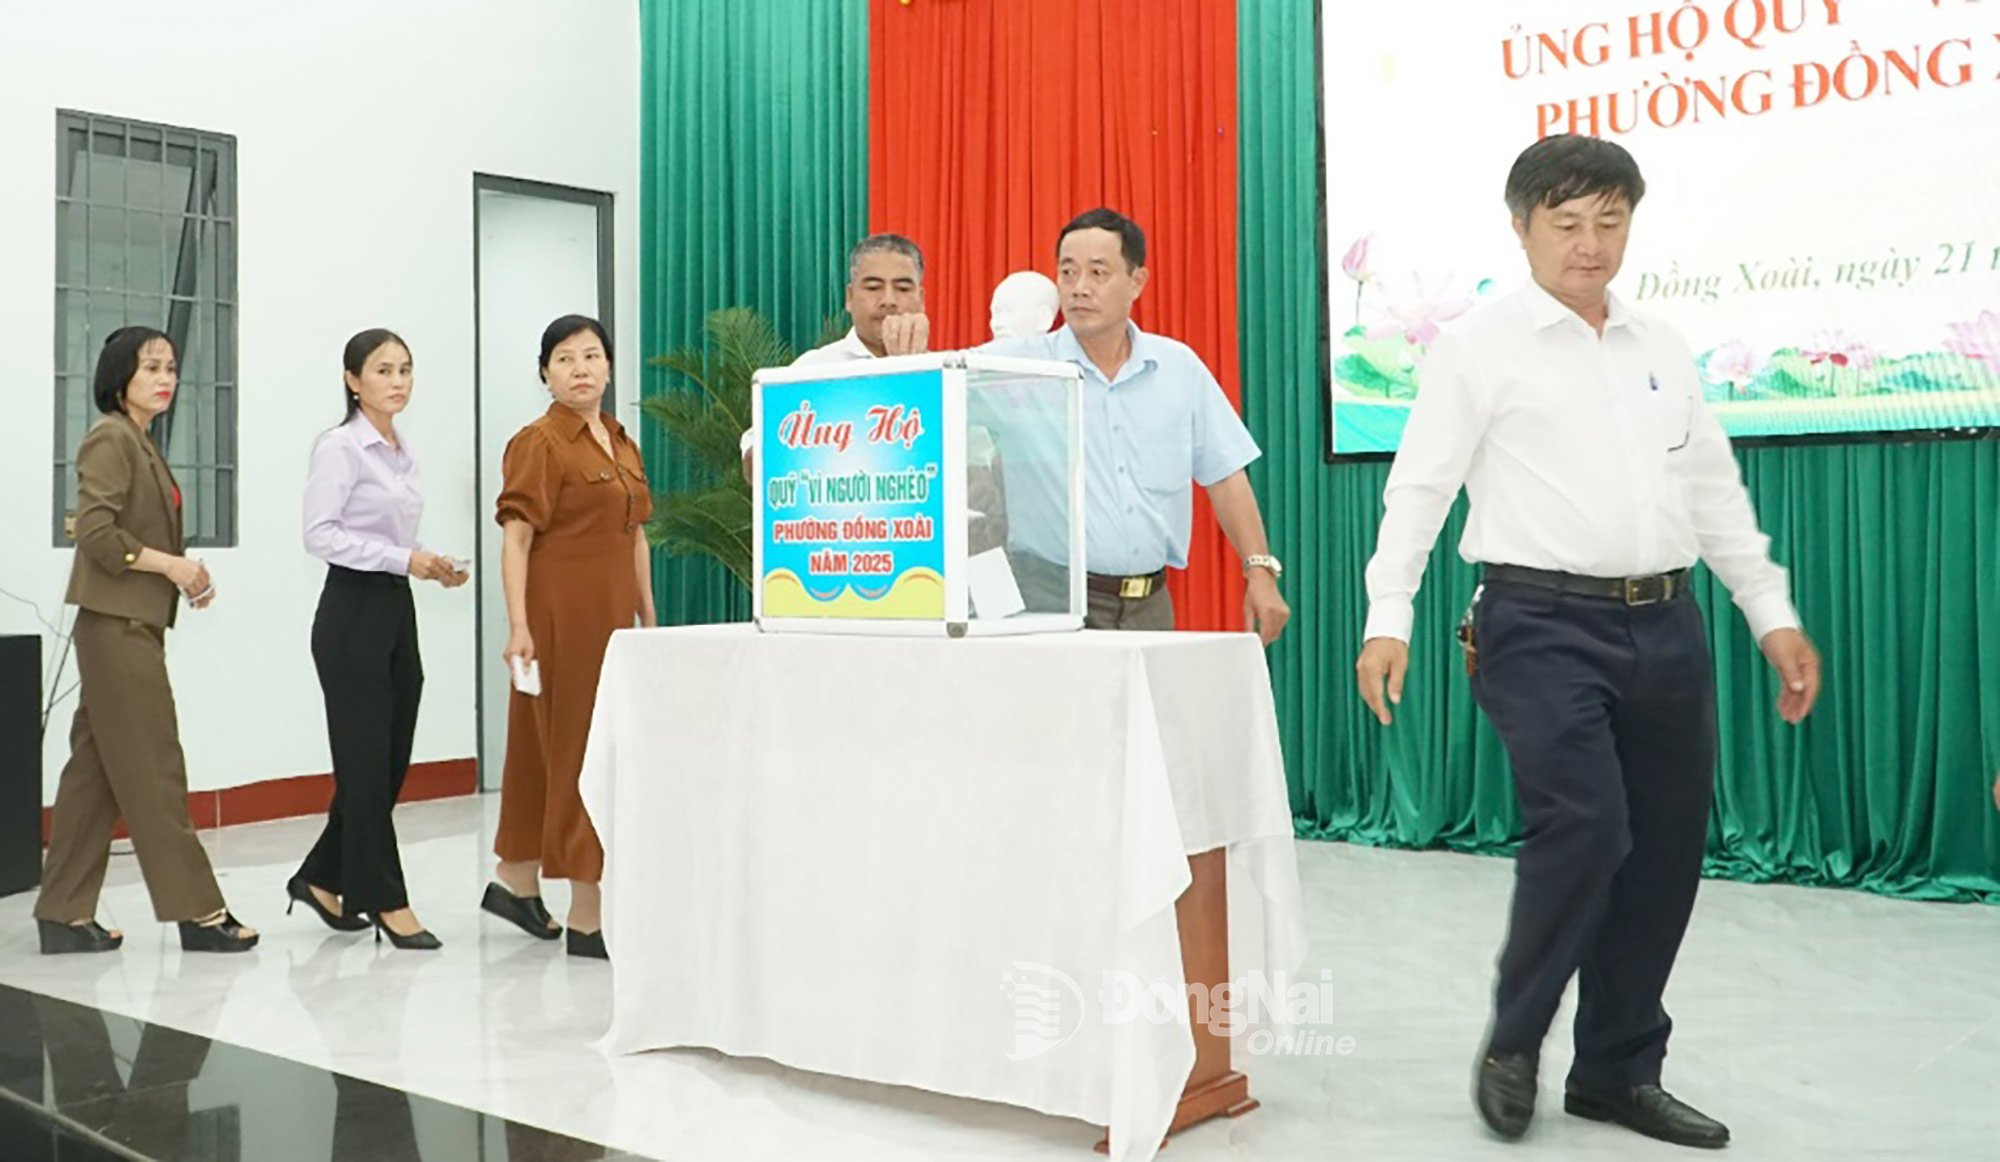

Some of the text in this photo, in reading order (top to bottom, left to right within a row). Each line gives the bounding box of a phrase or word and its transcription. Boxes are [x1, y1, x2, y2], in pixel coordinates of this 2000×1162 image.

[1536, 70, 1772, 143] PHƯỜNG
[1789, 38, 1972, 108] ĐỒNG
[1733, 256, 1820, 293] Xoài,
[1835, 246, 1921, 290] ngày
[1935, 240, 1976, 276] 21
[867, 405, 921, 448] Hộ
[827, 468, 871, 503] NGƯỜI
[774, 517, 838, 541] PHƯỜNG
[893, 514, 932, 539] XOÀI
[852, 553, 893, 573] 2025
